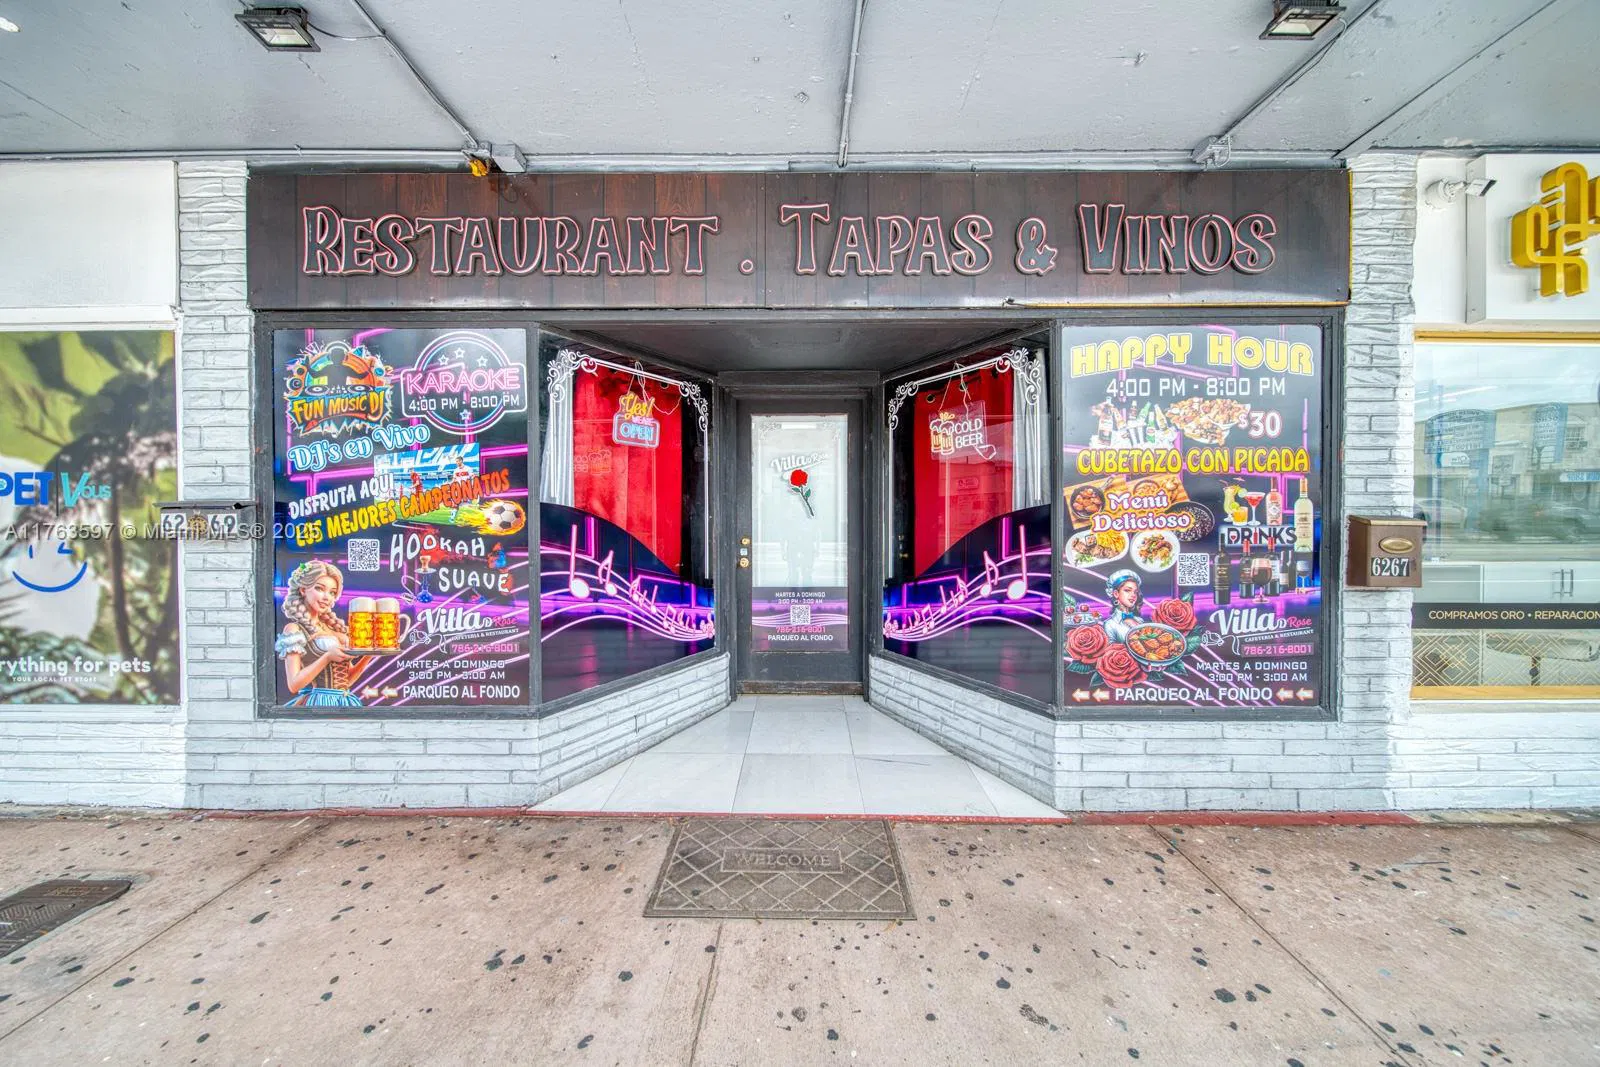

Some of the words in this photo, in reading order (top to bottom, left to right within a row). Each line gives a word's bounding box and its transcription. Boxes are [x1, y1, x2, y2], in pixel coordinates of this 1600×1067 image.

[303, 205, 718, 275] RESTAURANT
[780, 203, 993, 275] TAPAS
[1016, 217, 1058, 275] &
[1079, 203, 1277, 275] VINOS
[1070, 331, 1193, 378] HAPPY
[1207, 332, 1315, 376] HOUR
[406, 367, 521, 395] KARAOKE
[1106, 378, 1151, 397] 4:00
[1159, 377, 1186, 397] PM
[1206, 377, 1250, 397] 8:00
[1259, 376, 1286, 396] PM
[292, 398, 324, 424] FUN
[328, 394, 367, 416] MUSIC
[366, 389, 385, 421] DJ
[408, 398, 437, 412] 4:00
[441, 397, 458, 410] PM
[470, 395, 498, 409] 8:00
[502, 393, 520, 407] PM
[620, 422, 654, 441] OPEN
[954, 418, 982, 434] COLD
[1238, 410, 1282, 439] $30
[288, 439, 342, 471] DJ's
[343, 436, 374, 459] en
[372, 423, 431, 450] Vivo
[955, 432, 984, 448] BEER
[1076, 447, 1182, 474] CUBETAZO
[1187, 447, 1231, 474] CON
[1234, 448, 1310, 474] PICADA
[0, 471, 54, 506] PET
[289, 484, 356, 520] DISFRUTA
[360, 472, 394, 499] AQUI
[326, 502, 398, 539] MEJORES
[399, 468, 510, 517] CAMPEONATOS
[1106, 488, 1169, 511] Menú
[1092, 512, 1191, 532] Delicioso
[1227, 527, 1298, 545] DRINKS
[389, 533, 486, 573] HOOKAH
[1372, 557, 1410, 577] 6267
[438, 568, 510, 593] SUAVE
[416, 607, 484, 634] Villa
[1209, 607, 1278, 636] Villa
[1287, 616, 1313, 628] Rose
[1428, 610, 1498, 620] COMPRAMOS
[1500, 610, 1525, 620] ORO
[1534, 610, 1600, 620] REPARACION
[1243, 645, 1312, 655] 786-216-8001
[0, 656, 68, 677] rything
[73, 655, 104, 673] for
[109, 656, 151, 677] pets
[396, 660, 439, 669] MARTES
[442, 660, 450, 669] A
[454, 660, 505, 669] DOMINGO
[1196, 661, 1240, 671] MARTES
[1243, 661, 1251, 671] A
[1254, 661, 1308, 671] DOMINGO
[408, 671, 433, 680] 3:00
[436, 671, 452, 680] PM
[489, 671, 505, 680] AM
[1208, 673, 1233, 682] 3:00
[1237, 673, 1253, 682] PM
[1263, 673, 1288, 682] 3:00
[1291, 673, 1308, 682] AM
[402, 685, 459, 699] PARQUEO
[461, 685, 477, 698] AL
[479, 685, 521, 698] FONDO
[1115, 687, 1190, 702] PARQUEO
[1194, 687, 1213, 701] AL
[1218, 687, 1273, 701] FONDO
[734, 852, 831, 867] WELCOME
